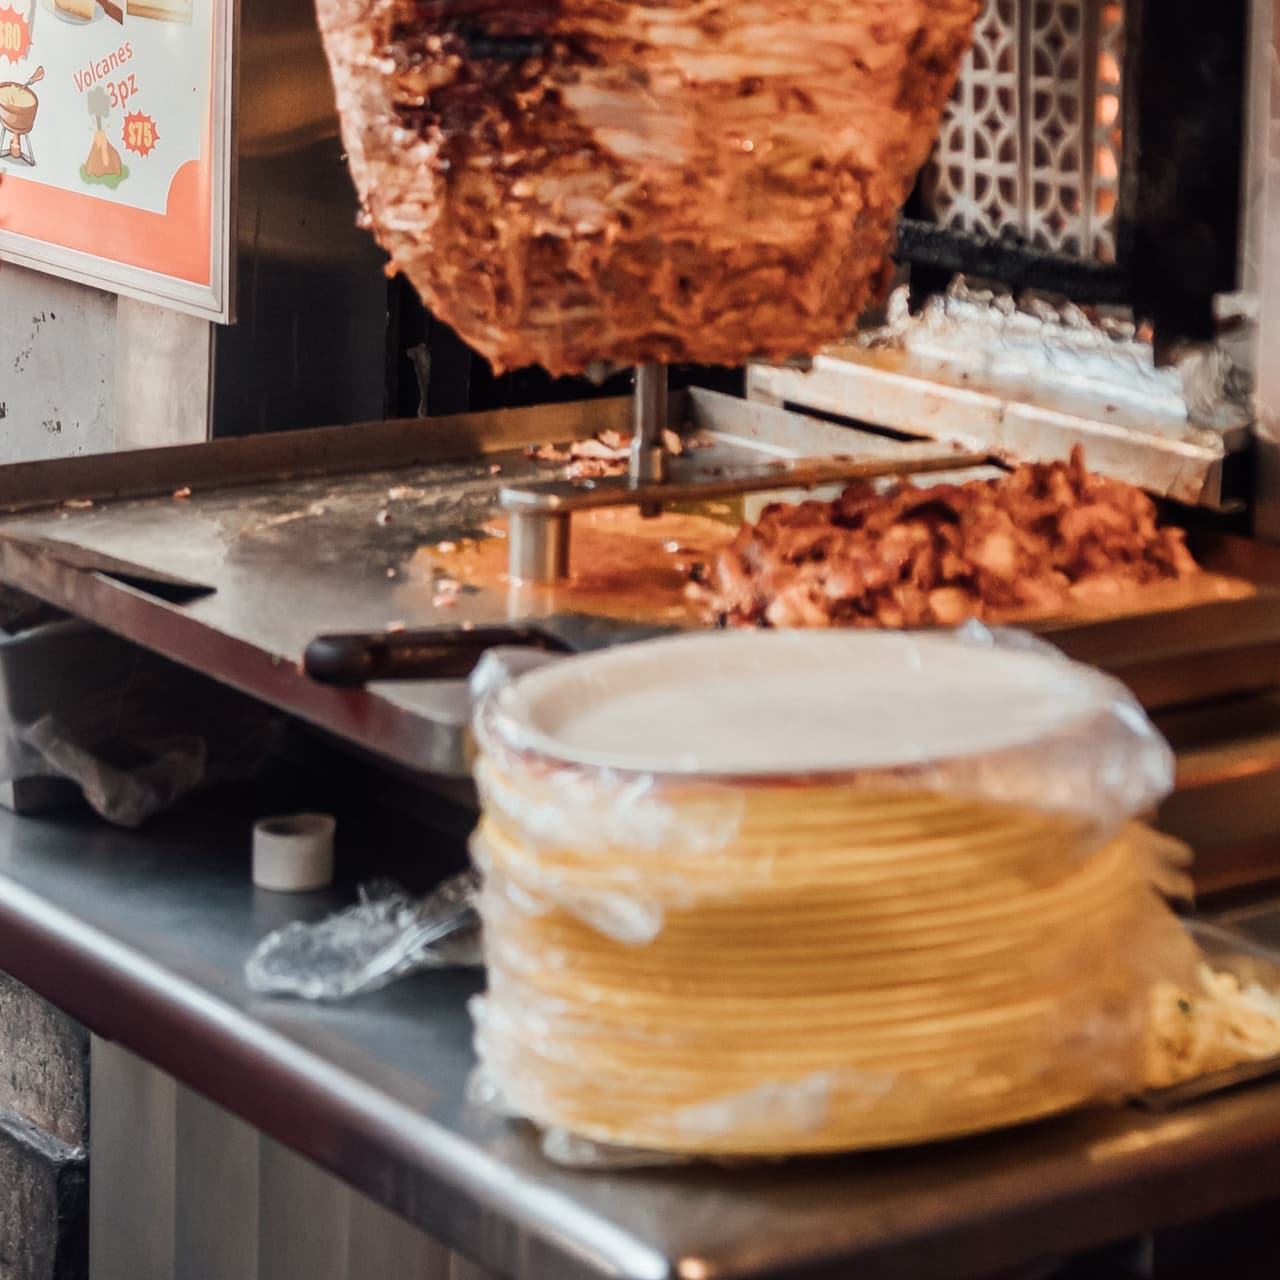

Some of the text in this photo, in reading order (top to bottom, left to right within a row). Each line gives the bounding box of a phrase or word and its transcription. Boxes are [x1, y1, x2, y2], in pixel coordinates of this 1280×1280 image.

[73, 42, 133, 93] Volcanes
[106, 73, 139, 109] 3pz
[128, 121, 153, 148] $75
